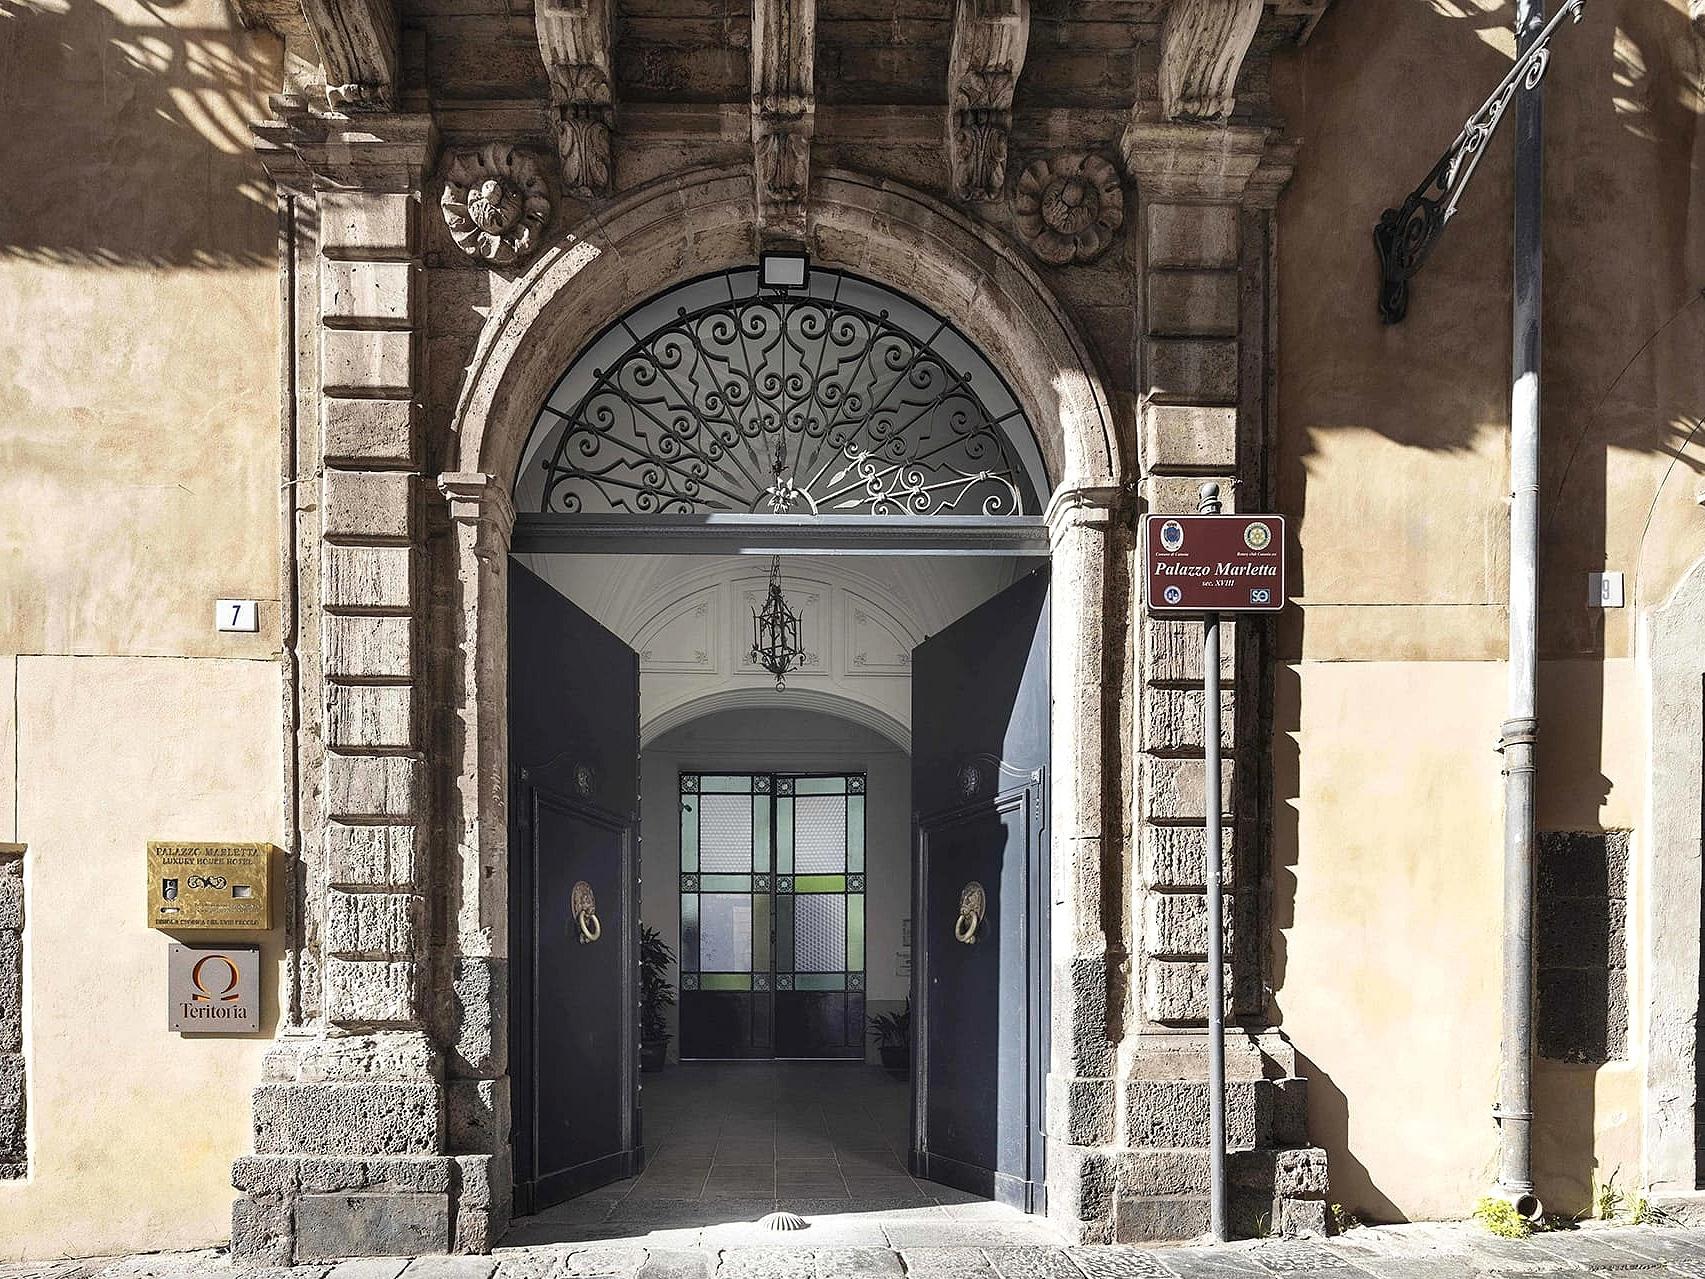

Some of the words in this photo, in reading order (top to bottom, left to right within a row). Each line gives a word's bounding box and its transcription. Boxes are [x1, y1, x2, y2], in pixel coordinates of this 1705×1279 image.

[1154, 562, 1211, 577] Palazzo
[1214, 562, 1277, 576] Marletta
[1215, 579, 1235, 587] XVIII
[1602, 579, 1610, 600] 9
[232, 605, 241, 626] 7
[156, 847, 202, 857] PALAZZO
[162, 857, 195, 865] LUXURY
[180, 1003, 247, 1019] Teritoria
